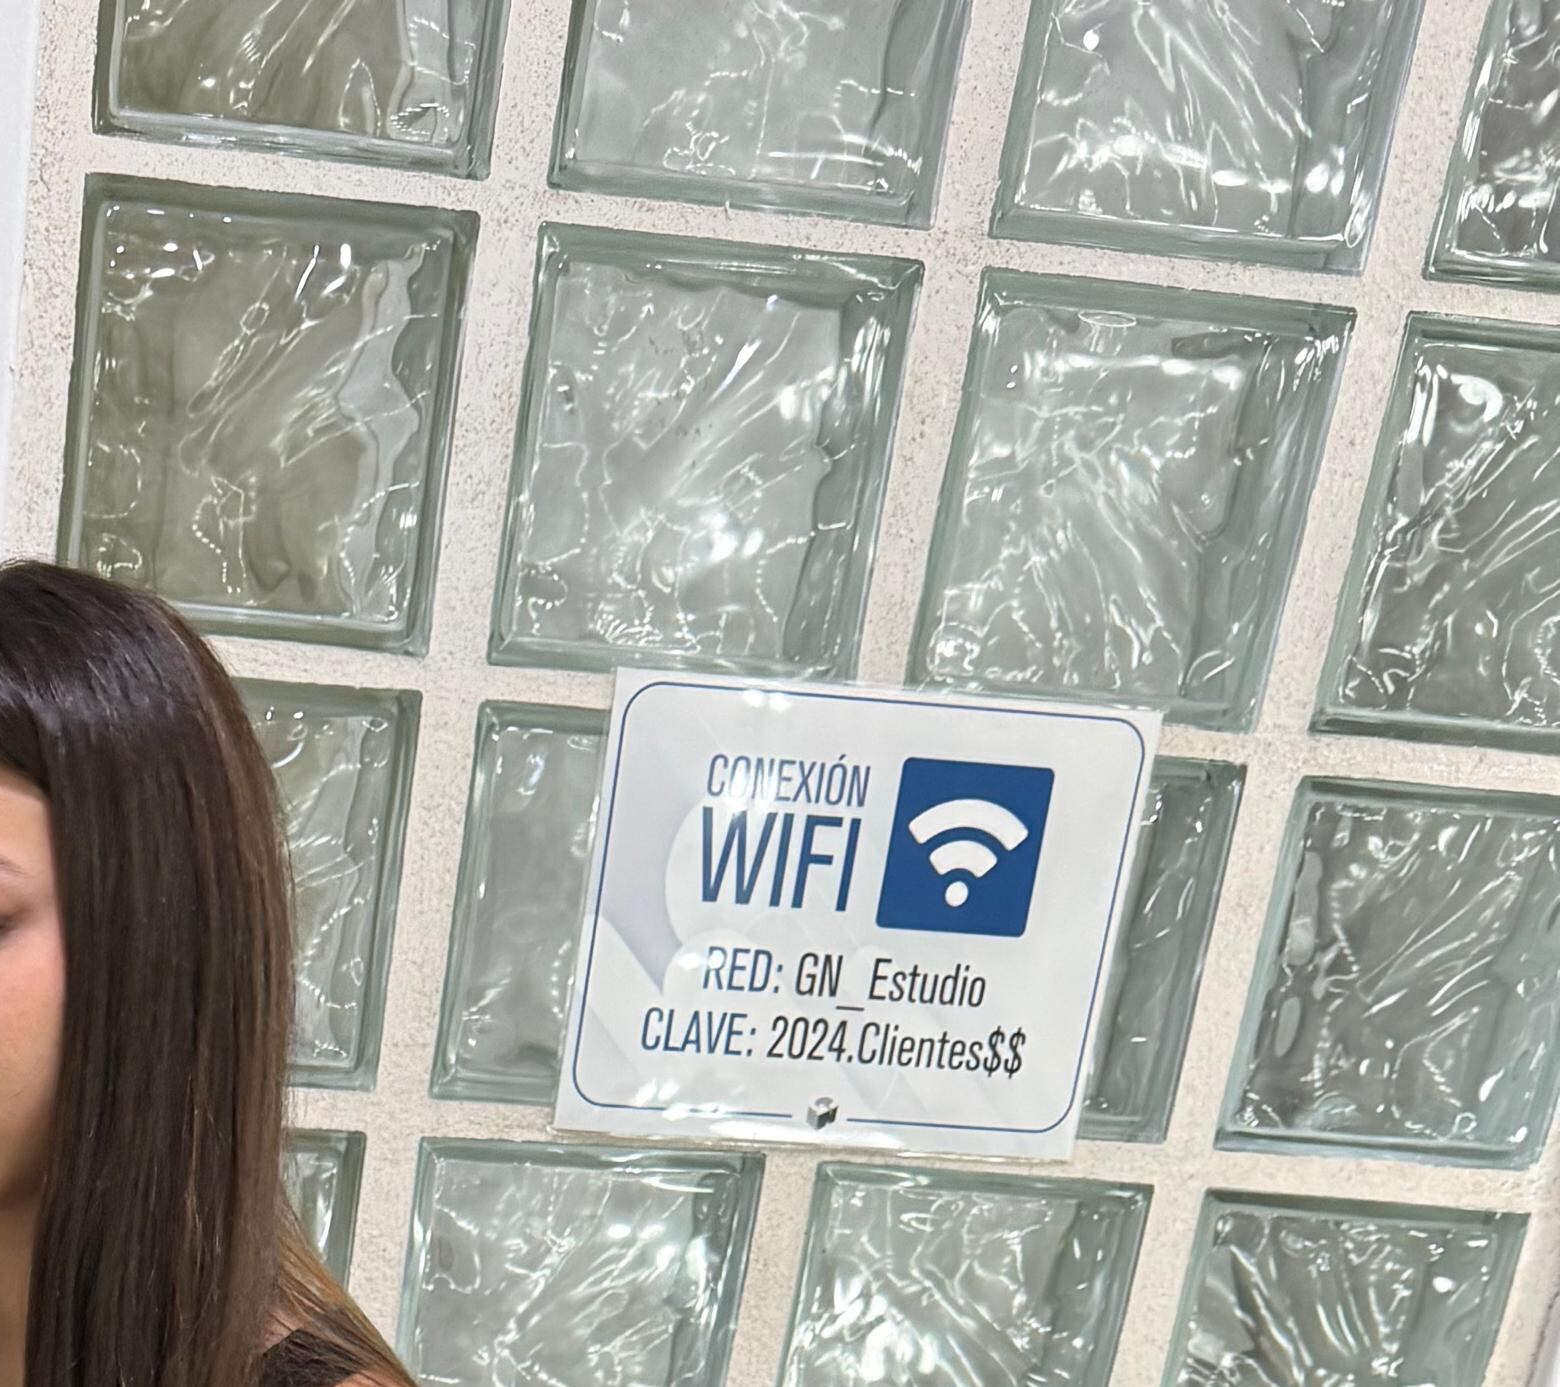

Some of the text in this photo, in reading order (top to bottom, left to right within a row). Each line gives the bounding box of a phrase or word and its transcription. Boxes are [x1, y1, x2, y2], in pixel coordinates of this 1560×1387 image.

[707, 754, 871, 807] CONEXIÓN
[701, 806, 862, 912] WIFI
[703, 946, 987, 1012] RED: GN_Estudio
[641, 1007, 1027, 1079] CLAVE: 2024.Clientes$$
